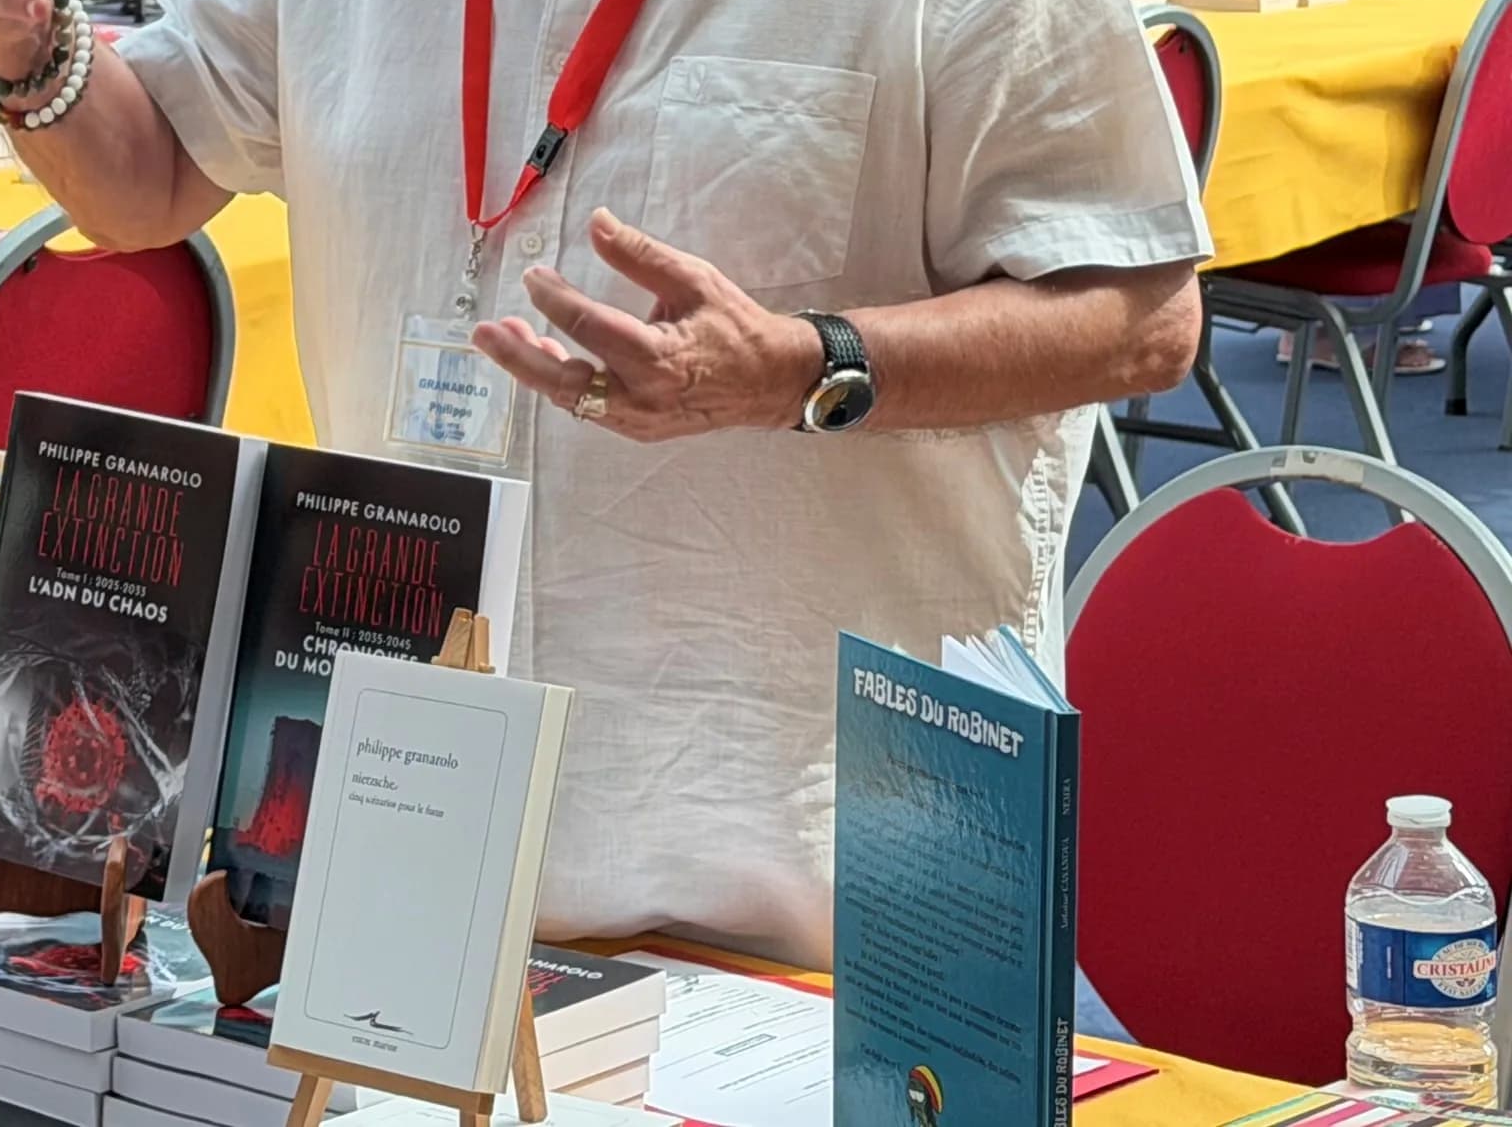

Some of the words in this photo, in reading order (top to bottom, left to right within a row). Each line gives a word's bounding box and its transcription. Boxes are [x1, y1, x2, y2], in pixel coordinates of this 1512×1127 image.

[418, 377, 489, 398] GRANAROLO
[429, 401, 473, 419] Philippe
[38, 440, 102, 467] PHILIPPE
[105, 455, 202, 489] GRANAROLO
[53, 466, 81, 519] LA
[87, 473, 185, 538] GRANDE
[296, 491, 359, 517] PHILIPPE
[363, 504, 461, 535] GRANAROLO
[39, 511, 185, 588] EXTINCTION
[313, 520, 341, 569] LA
[346, 526, 441, 588] GRANDE
[56, 566, 81, 584] Tome
[29, 575, 76, 601] L'ADN
[81, 588, 106, 608] DU
[109, 595, 168, 623] CHAOS
[299, 566, 444, 638] EXTINCTION
[315, 621, 339, 638] Tome
[358, 629, 412, 651] 2035-2045
[275, 650, 299, 670] DU
[853, 667, 917, 717] FABLES
[919, 695, 944, 727] DU
[356, 737, 403, 762] philippe
[404, 750, 459, 770] granarolo
[1055, 1076, 1068, 1095] DU
